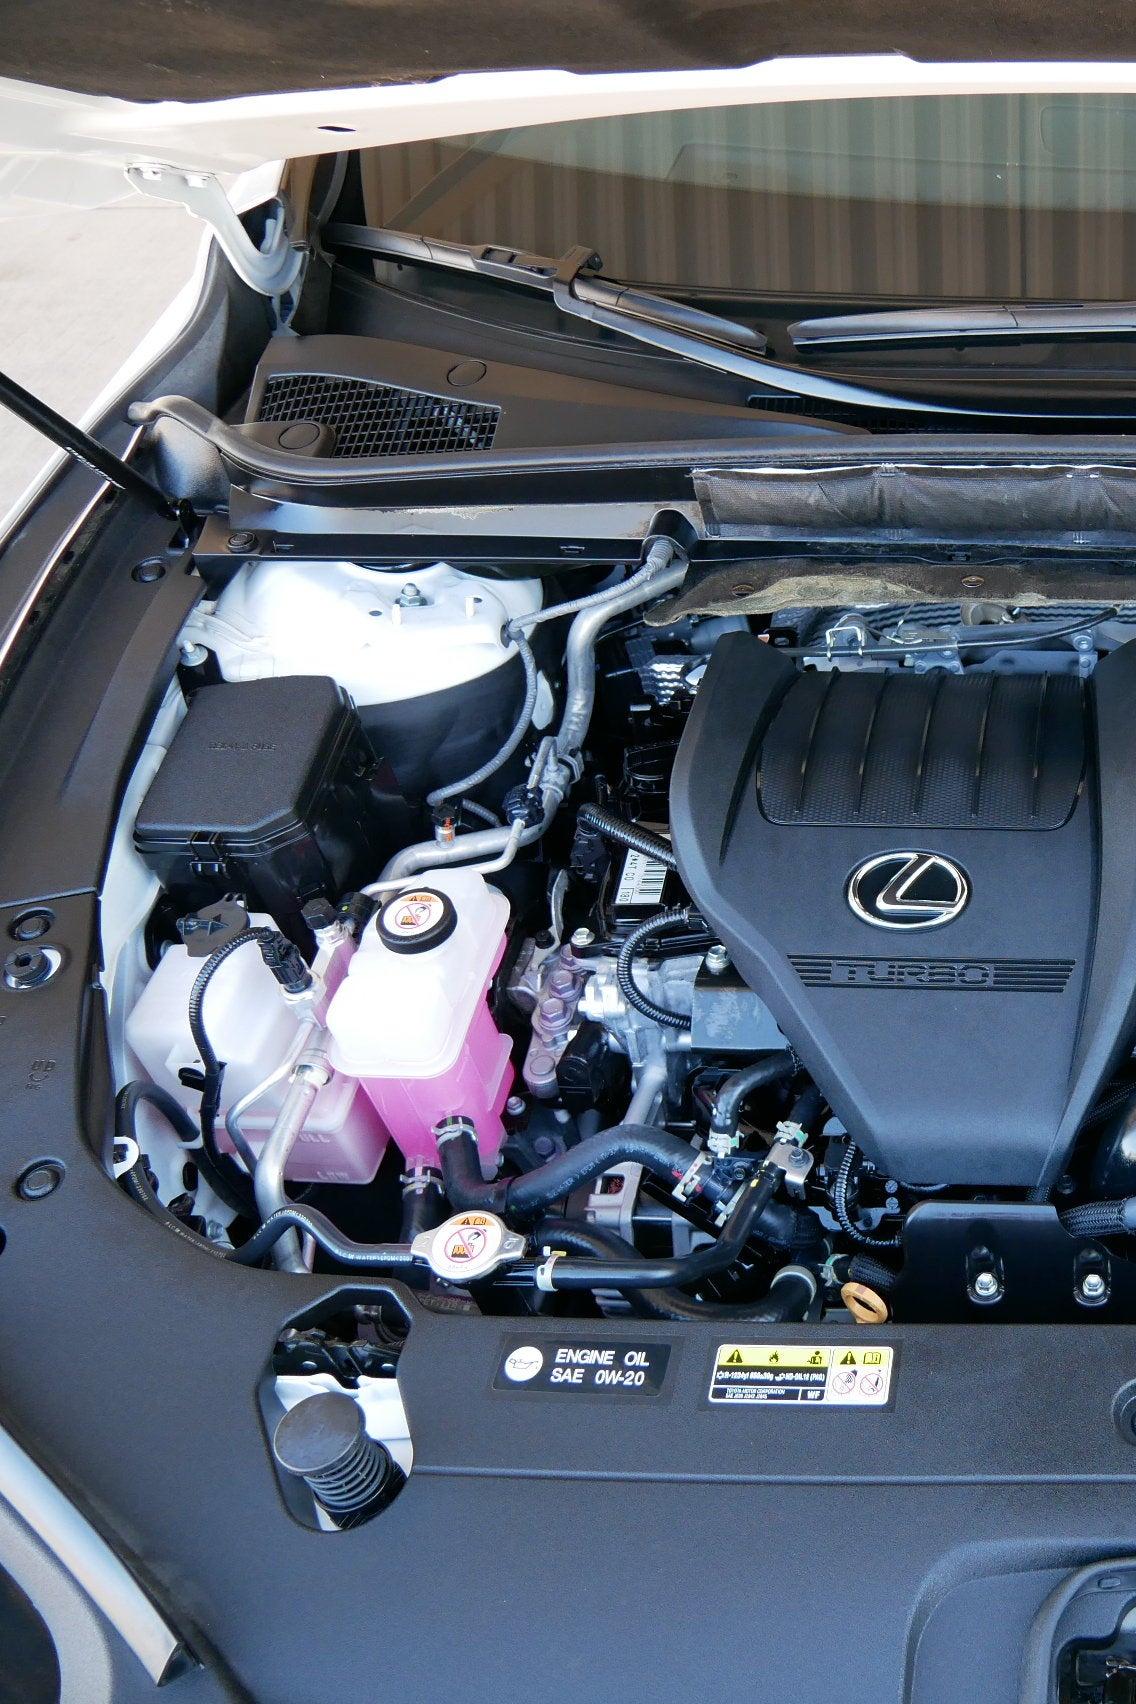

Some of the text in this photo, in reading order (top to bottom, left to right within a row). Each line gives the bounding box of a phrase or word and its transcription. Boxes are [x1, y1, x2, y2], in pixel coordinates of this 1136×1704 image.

[836, 961, 990, 984] TURBO
[554, 1348, 650, 1367] ENGINE OIL
[550, 1367, 646, 1386] SAE 0W-20
[807, 1390, 821, 1399] WF
